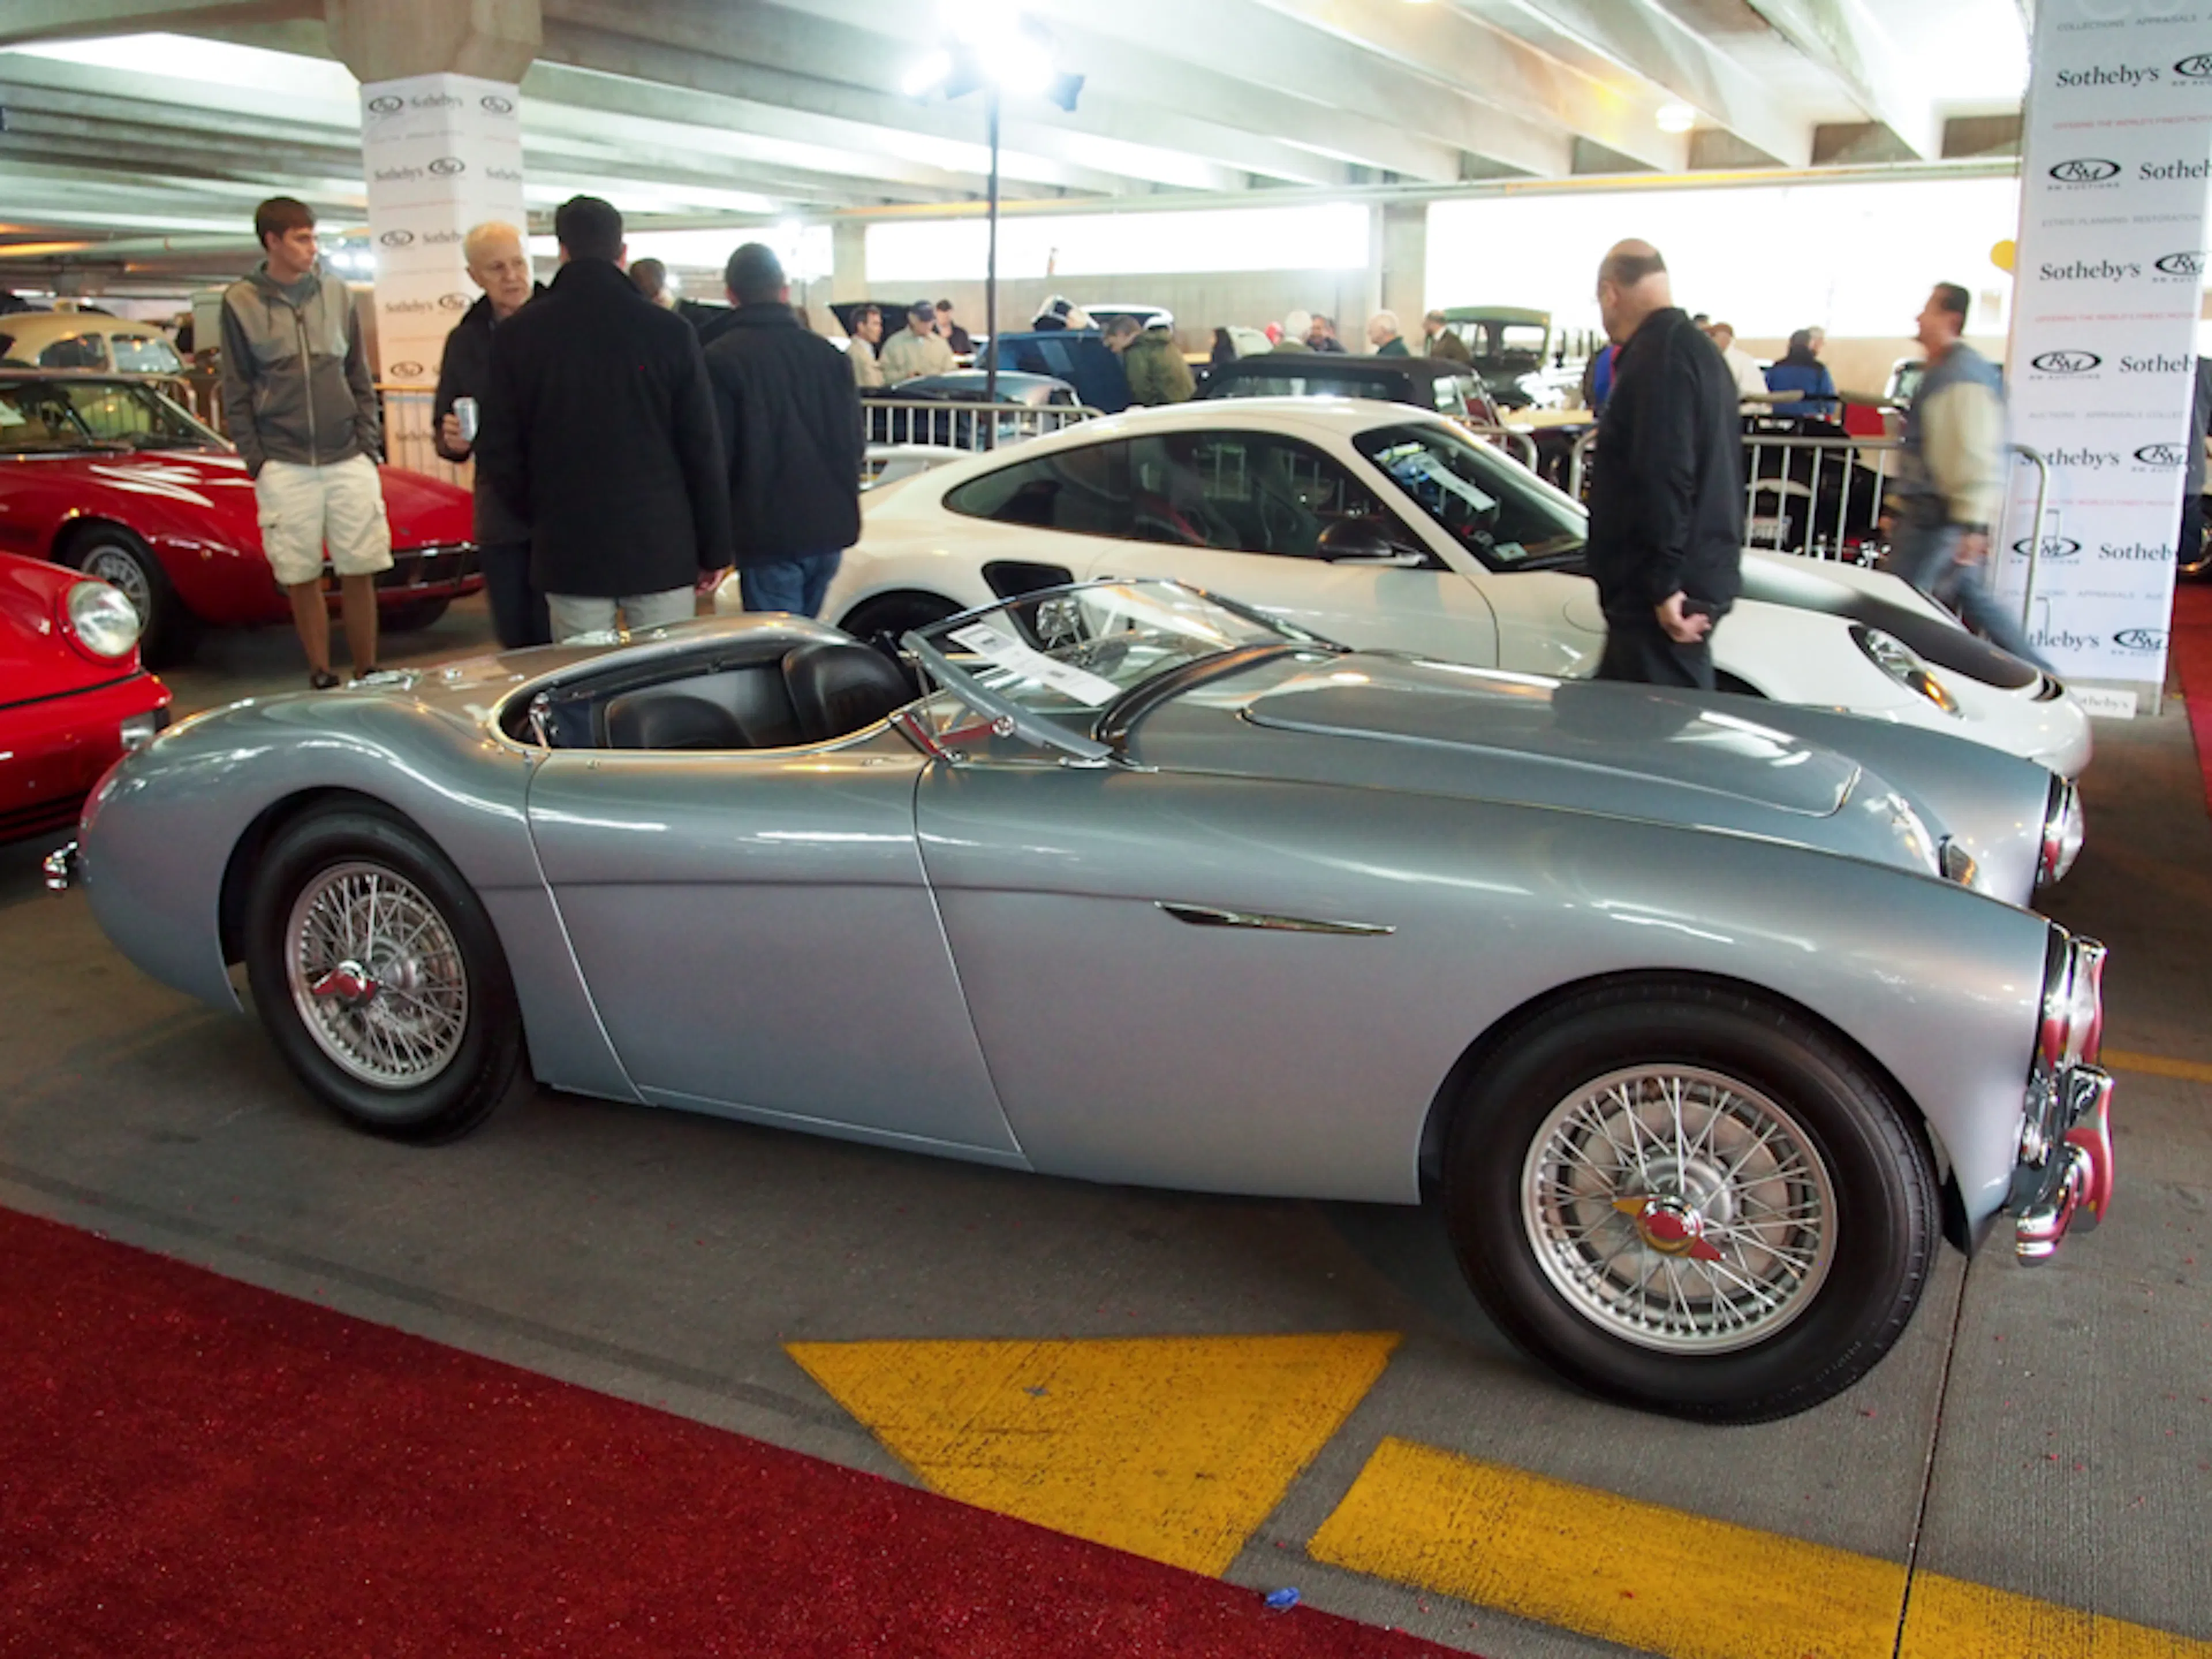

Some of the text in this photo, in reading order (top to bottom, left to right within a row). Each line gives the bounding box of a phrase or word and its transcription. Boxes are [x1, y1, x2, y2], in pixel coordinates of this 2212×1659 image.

[2056, 64, 2161, 88] Sotheby's
[2039, 259, 2142, 282] Sotheby's
[2098, 541, 2173, 562] Sotheb
